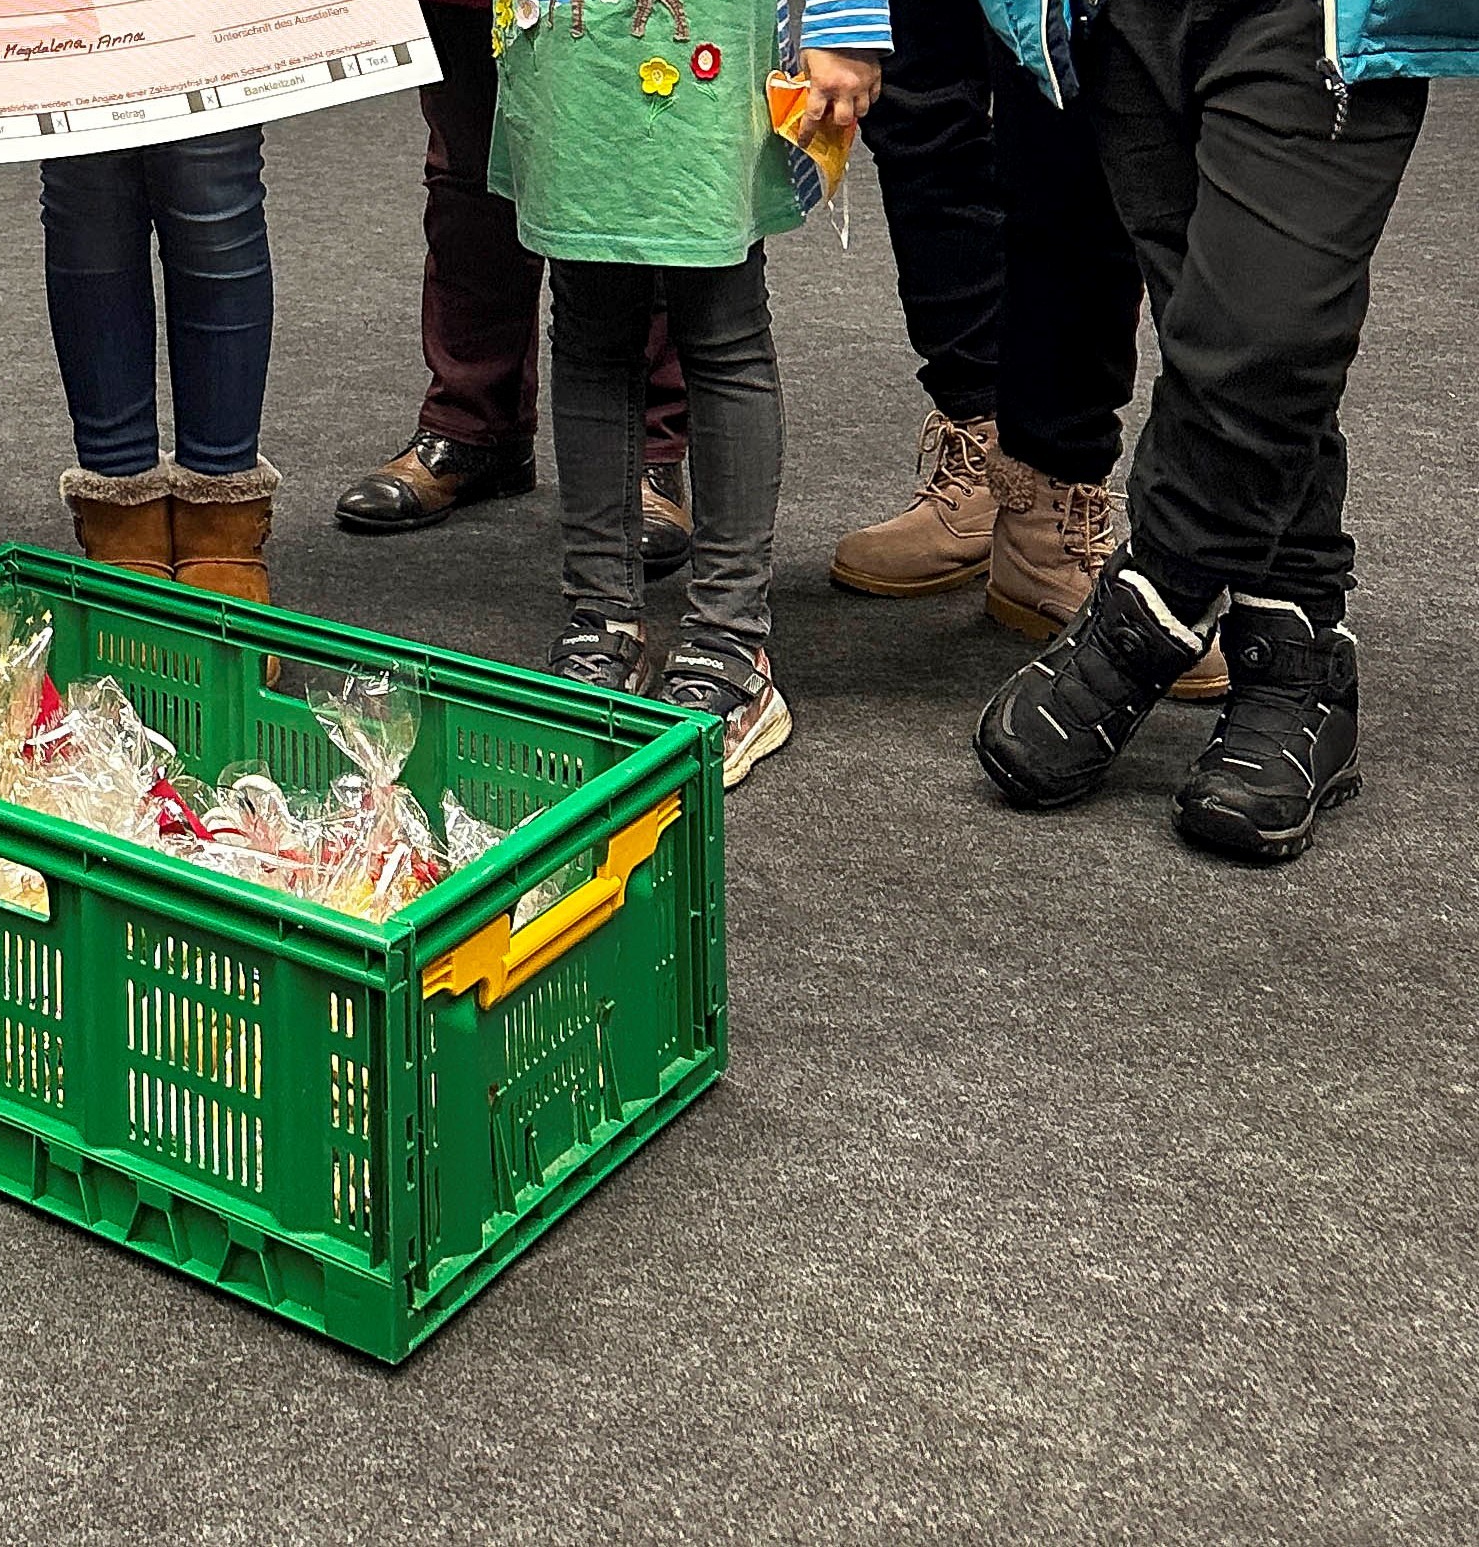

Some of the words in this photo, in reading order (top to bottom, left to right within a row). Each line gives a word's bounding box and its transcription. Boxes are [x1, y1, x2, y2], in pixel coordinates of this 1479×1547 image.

[214, 23, 272, 44] Unterschrift
[274, 18, 293, 30] des
[295, 5, 350, 26] Ausstellers
[97, 31, 146, 51] Anna
[367, 54, 389, 67] Text
[76, 97, 90, 107] Die
[92, 92, 125, 105] Angabe
[126, 89, 147, 99] einer
[205, 75, 219, 85] auf
[220, 71, 240, 82] dem
[240, 63, 272, 76] Scheck
[244, 74, 305, 97] Bankleitzahl
[112, 109, 146, 121] Betrag
